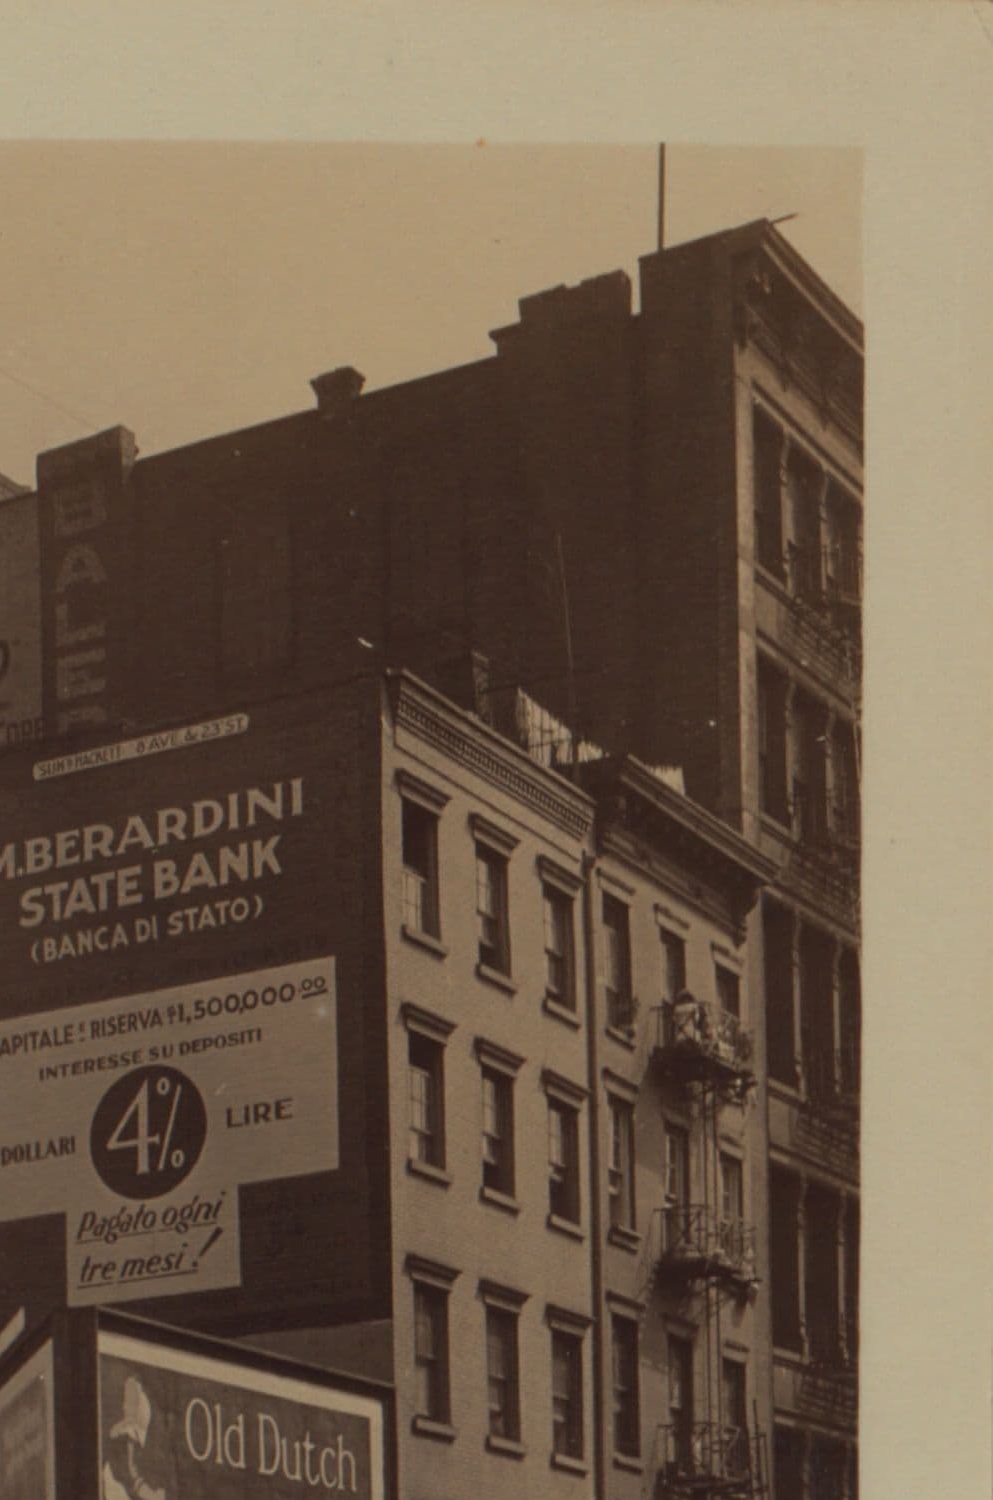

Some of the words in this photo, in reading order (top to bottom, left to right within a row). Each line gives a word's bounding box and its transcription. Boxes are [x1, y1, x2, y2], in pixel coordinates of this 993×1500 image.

[184, 728, 197, 742] &
[19, 864, 144, 928] STATE
[154, 835, 283, 900] BANK
[30, 916, 129, 965] (BANCA
[135, 917, 158, 943] DI
[167, 896, 264, 935] STATO)
[90, 1007, 164, 1039] RISERVA
[38, 1048, 144, 1082] INTERESSE
[149, 1042, 175, 1061] SU
[178, 1027, 263, 1057] DEPOSITI
[105, 1077, 185, 1175] 4%
[225, 1097, 294, 1129] LIRE
[0, 1135, 76, 1167] DOLLARI
[77, 1202, 157, 1244] Pagato
[161, 1190, 226, 1234] ogni
[79, 1253, 115, 1283] tre
[184, 1396, 246, 1470] Old
[256, 1411, 358, 1493] Dutch
